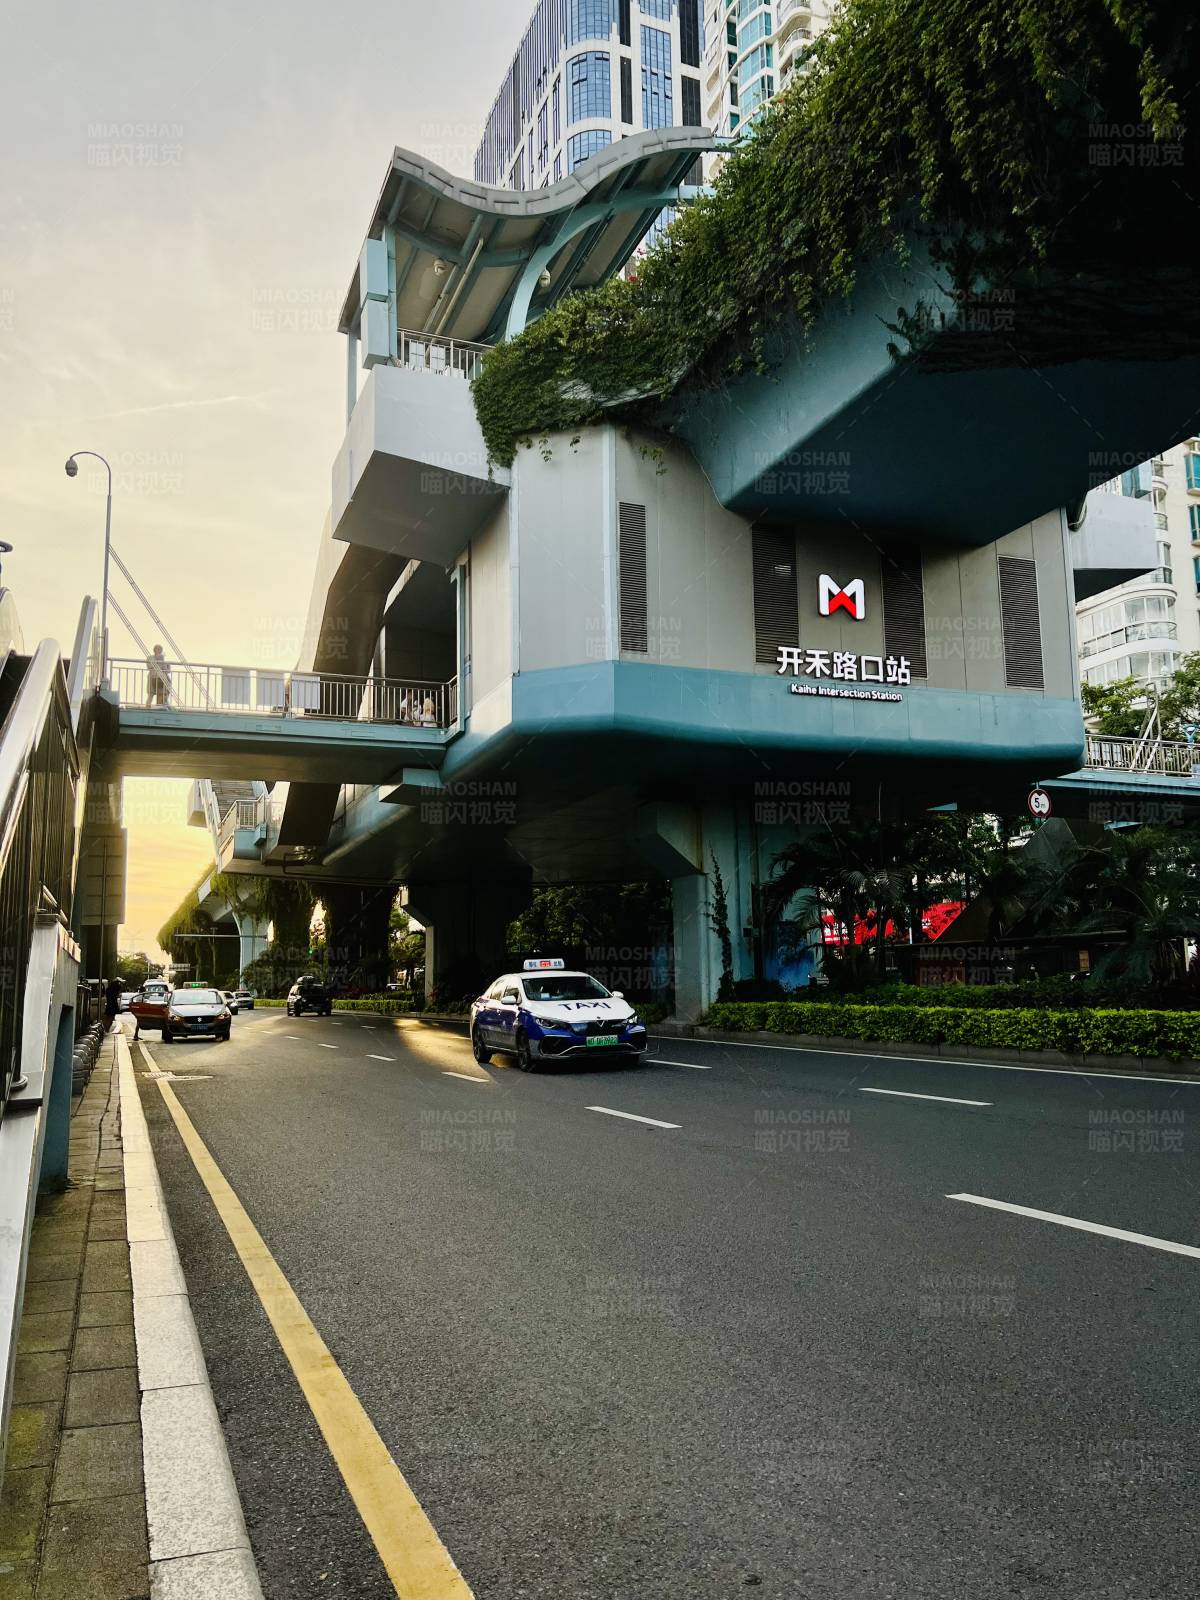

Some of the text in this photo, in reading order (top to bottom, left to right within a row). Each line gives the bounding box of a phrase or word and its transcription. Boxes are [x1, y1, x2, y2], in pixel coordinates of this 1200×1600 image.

[776, 646, 911, 685] 开禾路口站
[791, 683, 903, 701] Kaihe Intersection Station
[559, 1002, 612, 1011] TAXI
